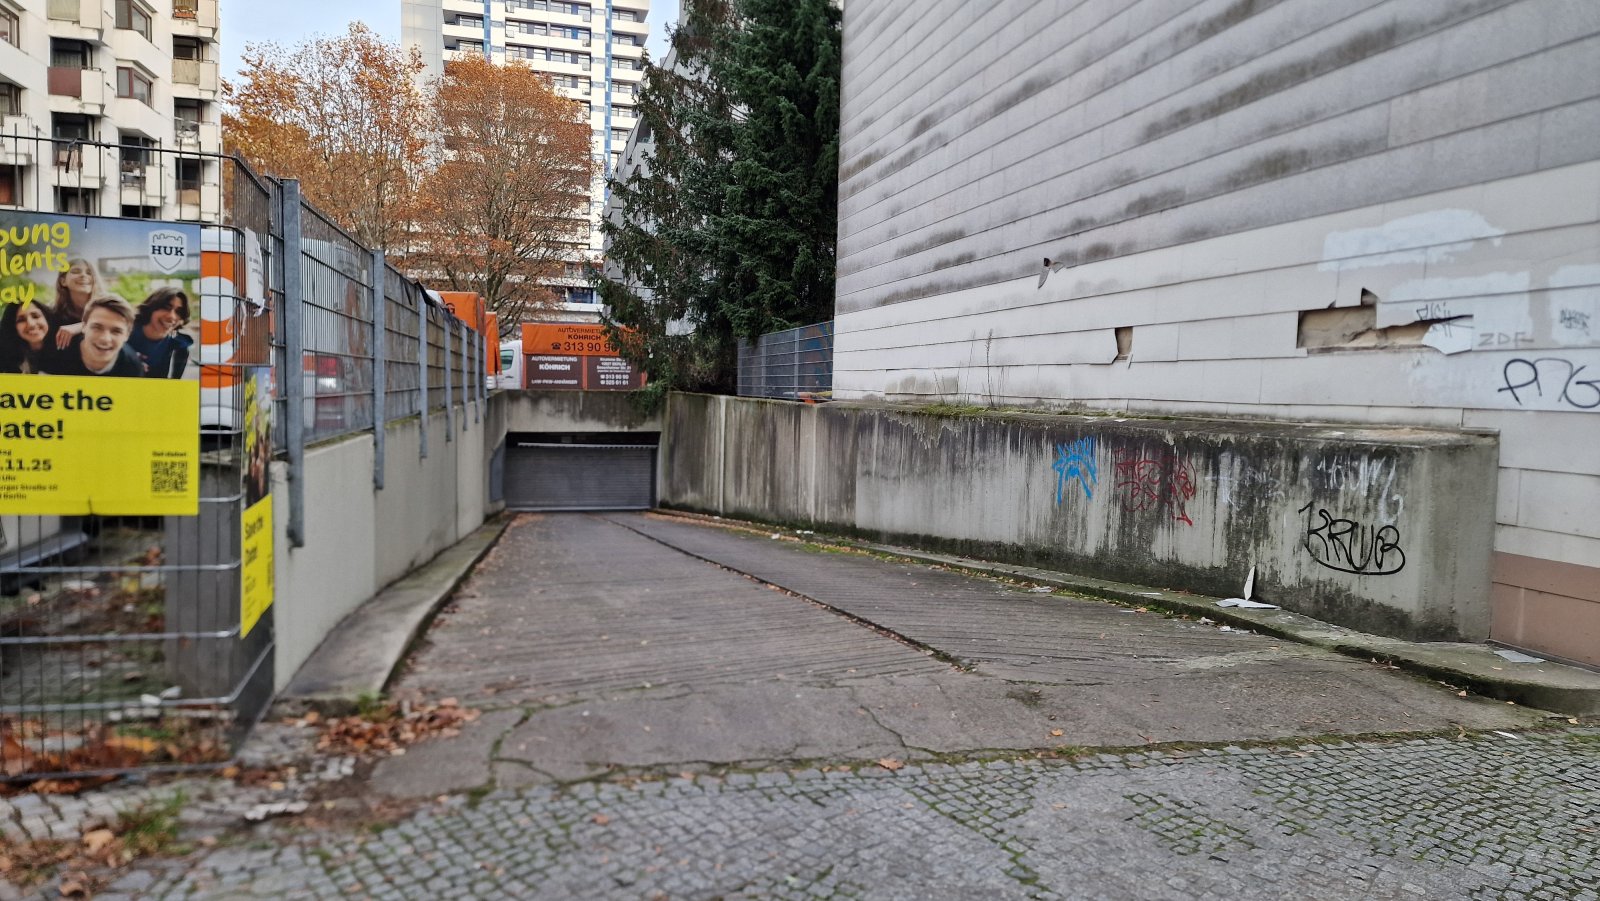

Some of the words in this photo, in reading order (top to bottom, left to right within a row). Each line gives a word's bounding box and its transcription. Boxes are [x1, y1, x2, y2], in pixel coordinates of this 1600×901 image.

[0, 222, 70, 248] oung
[152, 245, 184, 256] HUK
[0, 245, 70, 276] lents
[0, 282, 34, 312] ay
[557, 326, 602, 334] AUTOVERMIET
[564, 341, 584, 352] 313
[587, 342, 601, 352] 90
[0, 393, 54, 410] ave
[61, 389, 113, 411] the
[0, 420, 64, 439] ate!
[0, 458, 52, 471] .11.25
